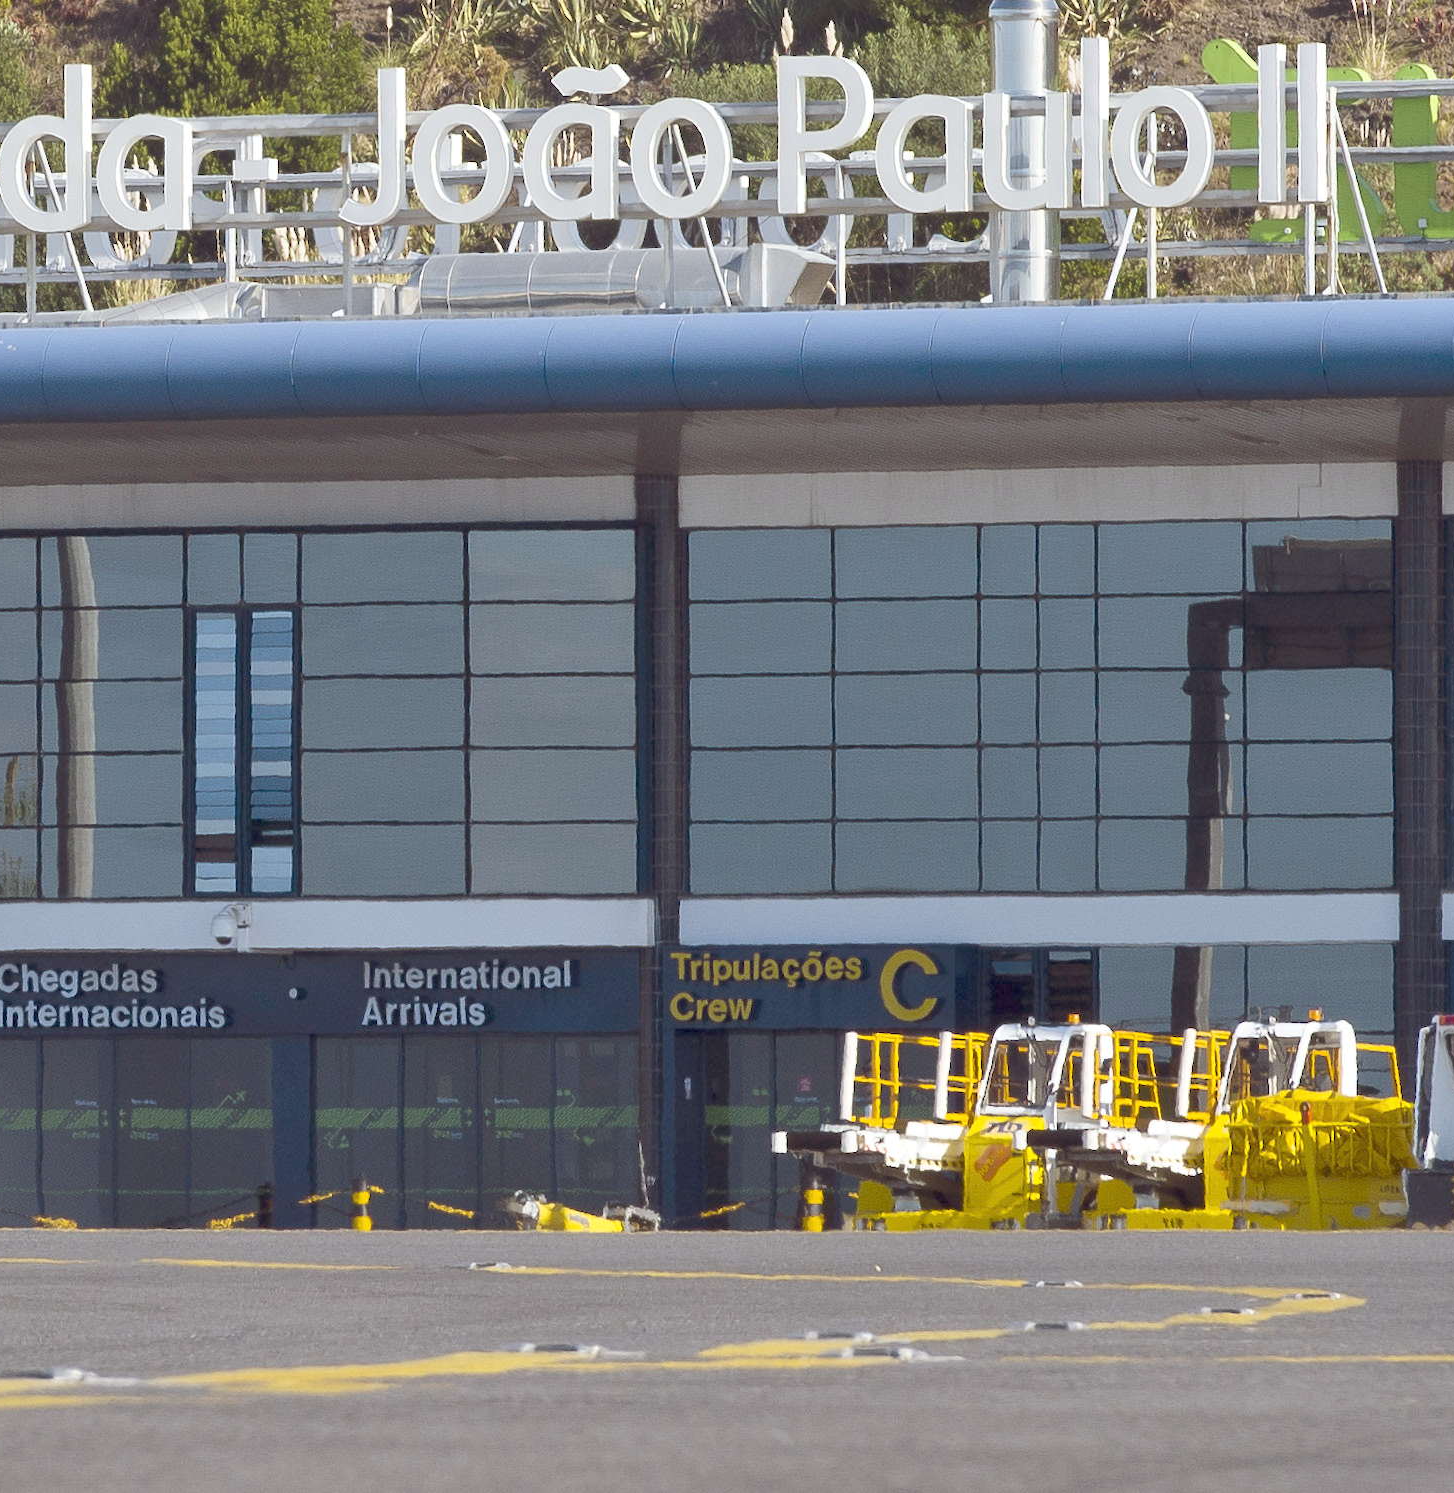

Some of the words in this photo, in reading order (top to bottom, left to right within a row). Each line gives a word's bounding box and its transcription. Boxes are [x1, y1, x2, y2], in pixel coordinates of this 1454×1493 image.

[340, 63, 732, 227] João
[777, 37, 1214, 214] Paulo
[1257, 42, 1327, 203] II
[363, 958, 572, 990] International
[670, 950, 862, 987] Tripulações
[879, 949, 939, 1022] C
[361, 996, 486, 1026] Arrivals
[669, 992, 753, 1022] Crew
